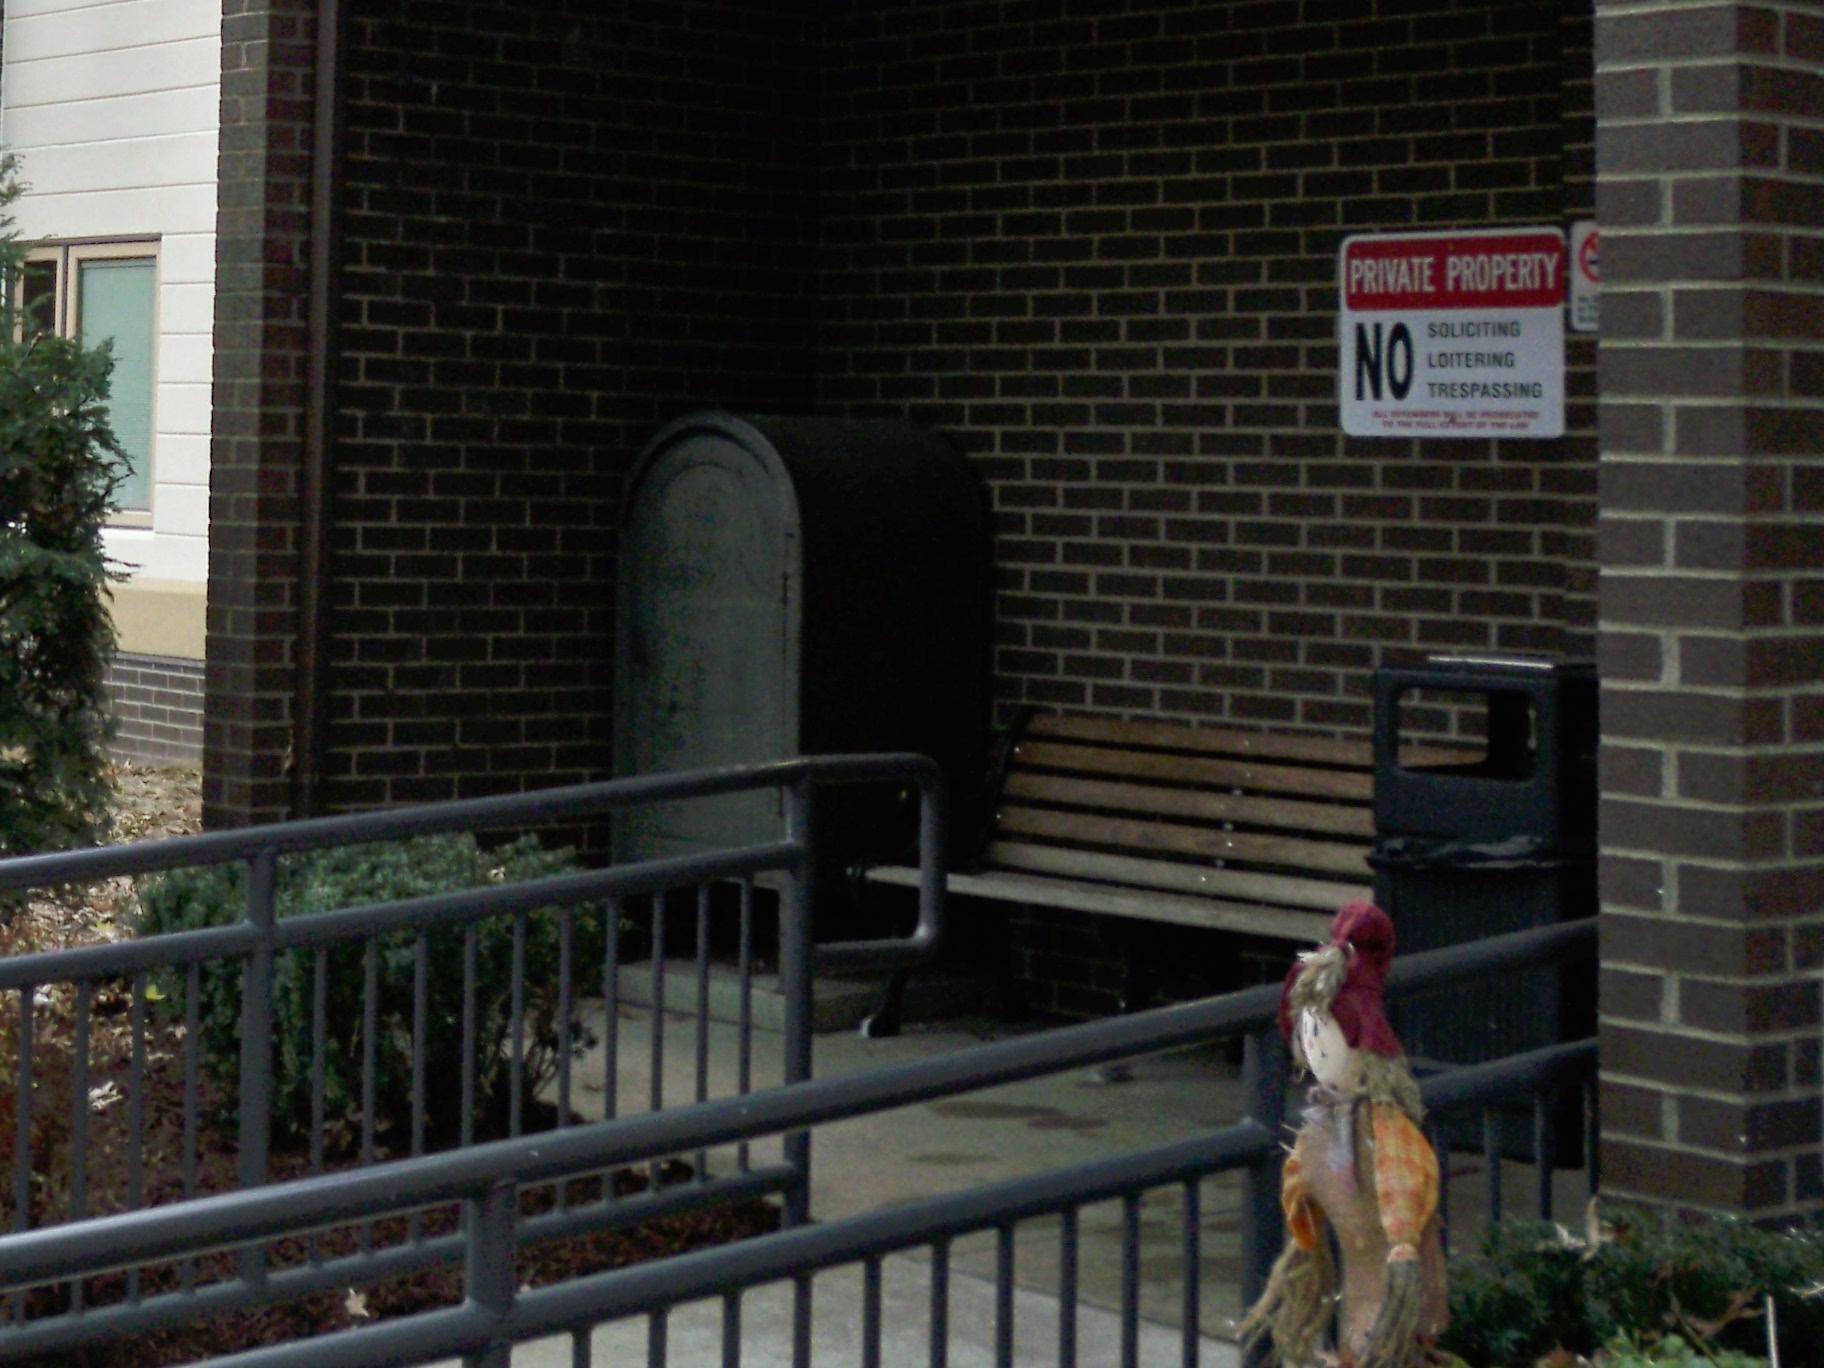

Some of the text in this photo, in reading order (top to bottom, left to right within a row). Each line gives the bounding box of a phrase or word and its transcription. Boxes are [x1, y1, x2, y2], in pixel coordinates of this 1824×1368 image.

[1350, 252, 1560, 294] PRIVATE PROPERTY
[1427, 321, 1521, 338] SOLICITING
[1355, 322, 1414, 401] NO
[1427, 352, 1515, 369] LOITERING
[1427, 382, 1543, 399] TRESPASSING
